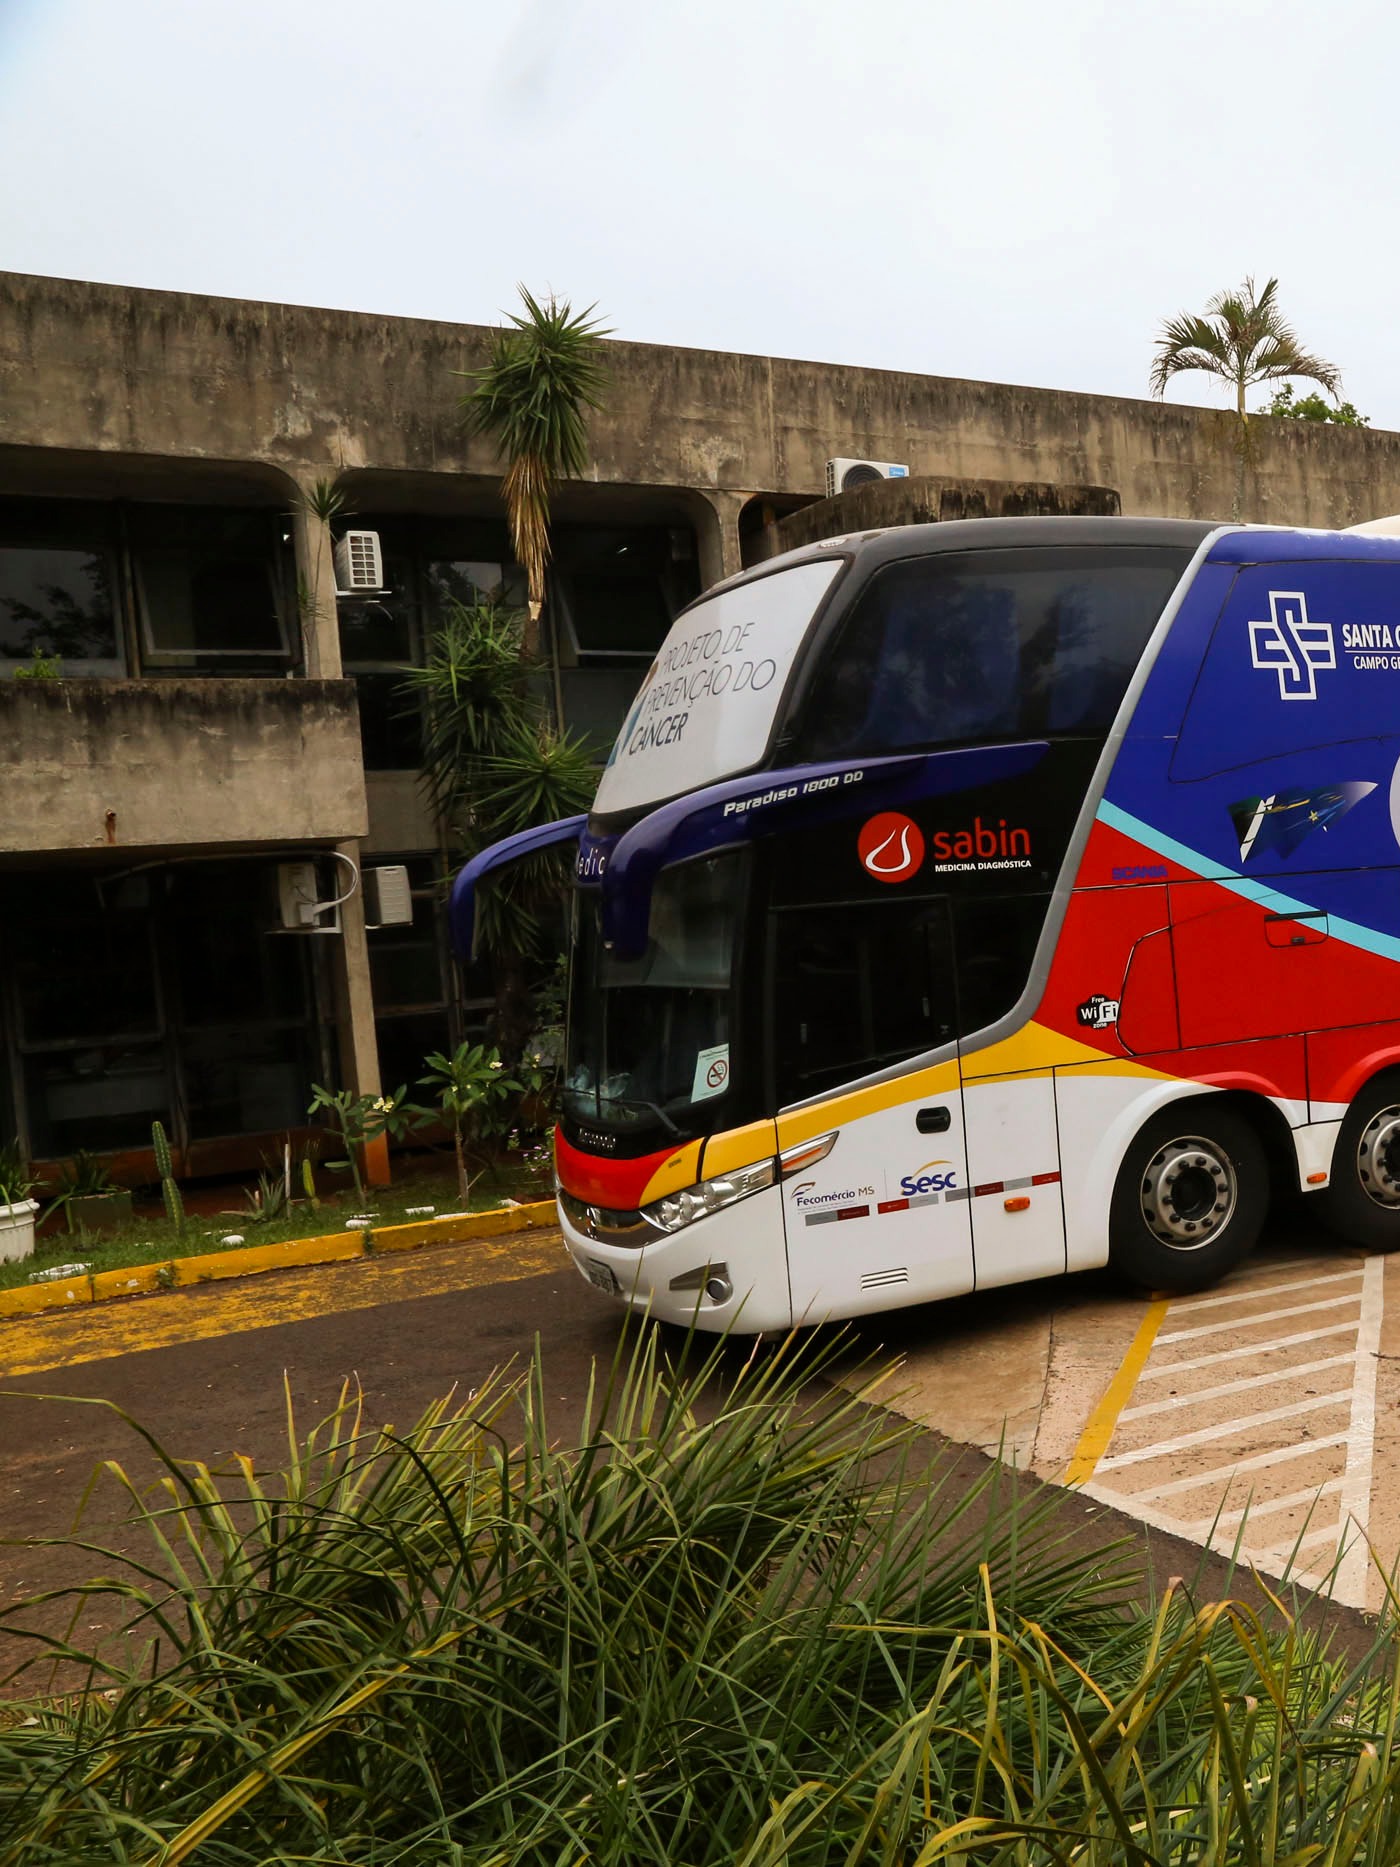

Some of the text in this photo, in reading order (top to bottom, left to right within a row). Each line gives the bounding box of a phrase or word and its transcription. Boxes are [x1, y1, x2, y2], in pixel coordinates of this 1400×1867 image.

[722, 622, 755, 655] DE
[1342, 624, 1393, 648] SANTA
[1353, 656, 1389, 670] CAMPO
[643, 659, 776, 715] PREVENÇÃO DO
[629, 711, 689, 755] CÂNCER
[723, 770, 864, 817] Paradiso 1800 DD
[933, 816, 1031, 860] sabin
[934, 860, 1032, 873] MEDICINA DIAGNÓSTICA
[1111, 864, 1168, 881] SCANIA
[796, 1190, 856, 1207] Fecomércio
[858, 1185, 875, 1198] MS
